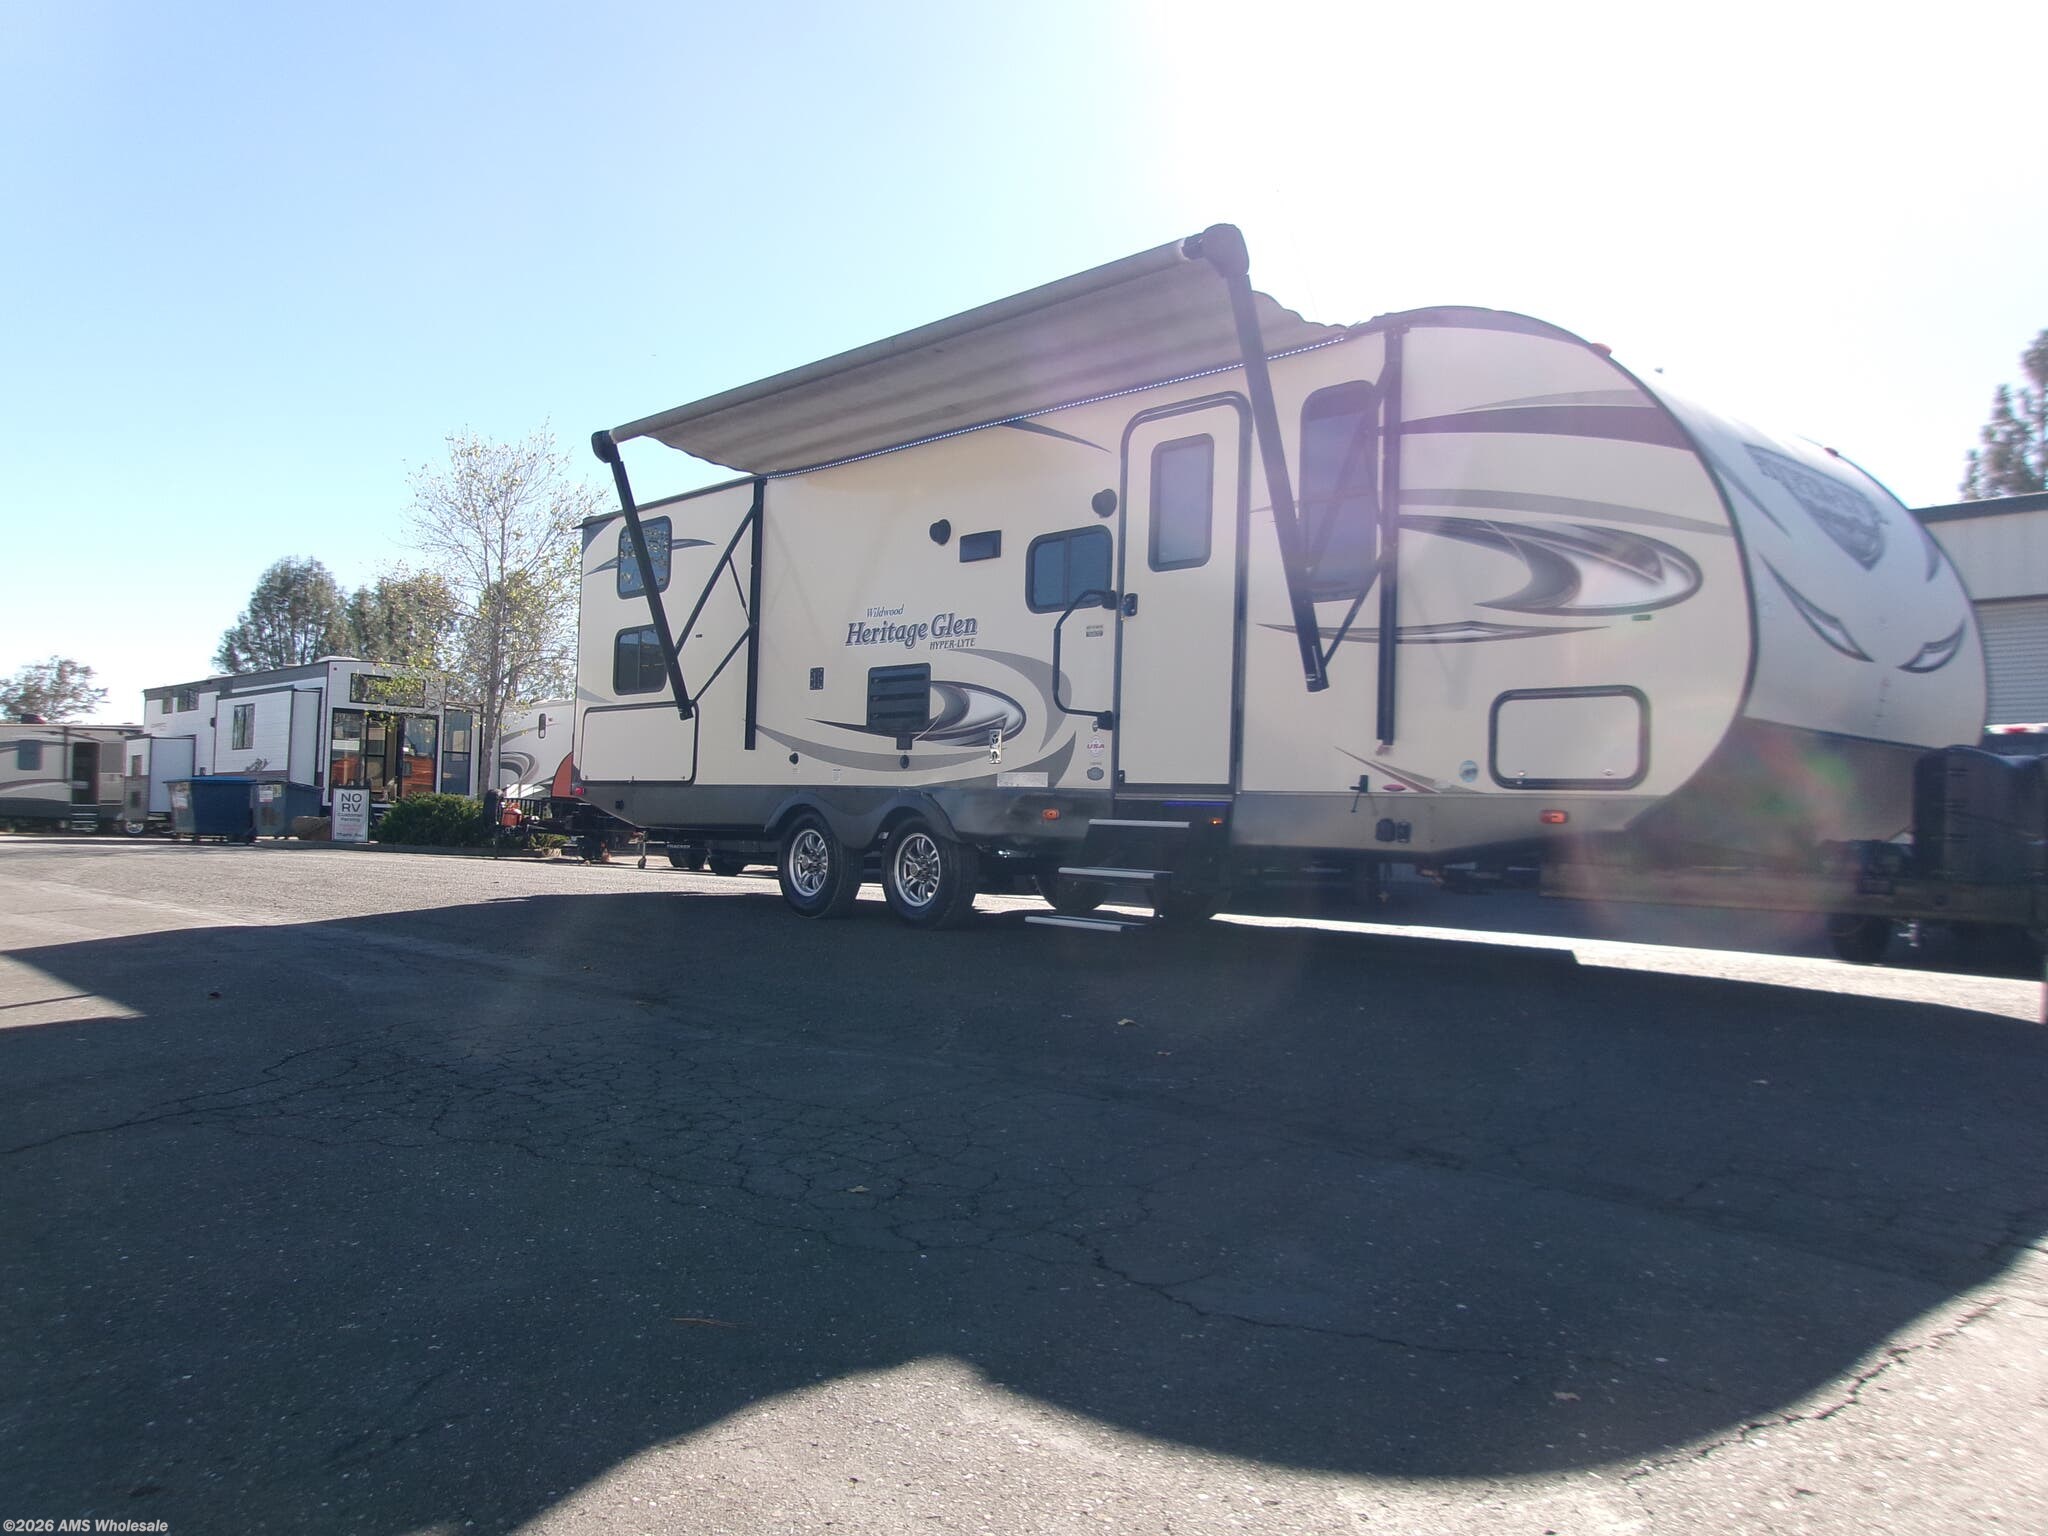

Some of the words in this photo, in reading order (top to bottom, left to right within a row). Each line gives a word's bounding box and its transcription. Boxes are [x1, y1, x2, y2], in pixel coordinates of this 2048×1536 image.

[866, 604, 904, 618] Wildwood
[845, 620, 928, 649] Heritage
[931, 613, 977, 639] Glen
[929, 638, 976, 650] HYPER-LYTE
[341, 793, 362, 802] NO
[341, 802, 361, 812] RV
